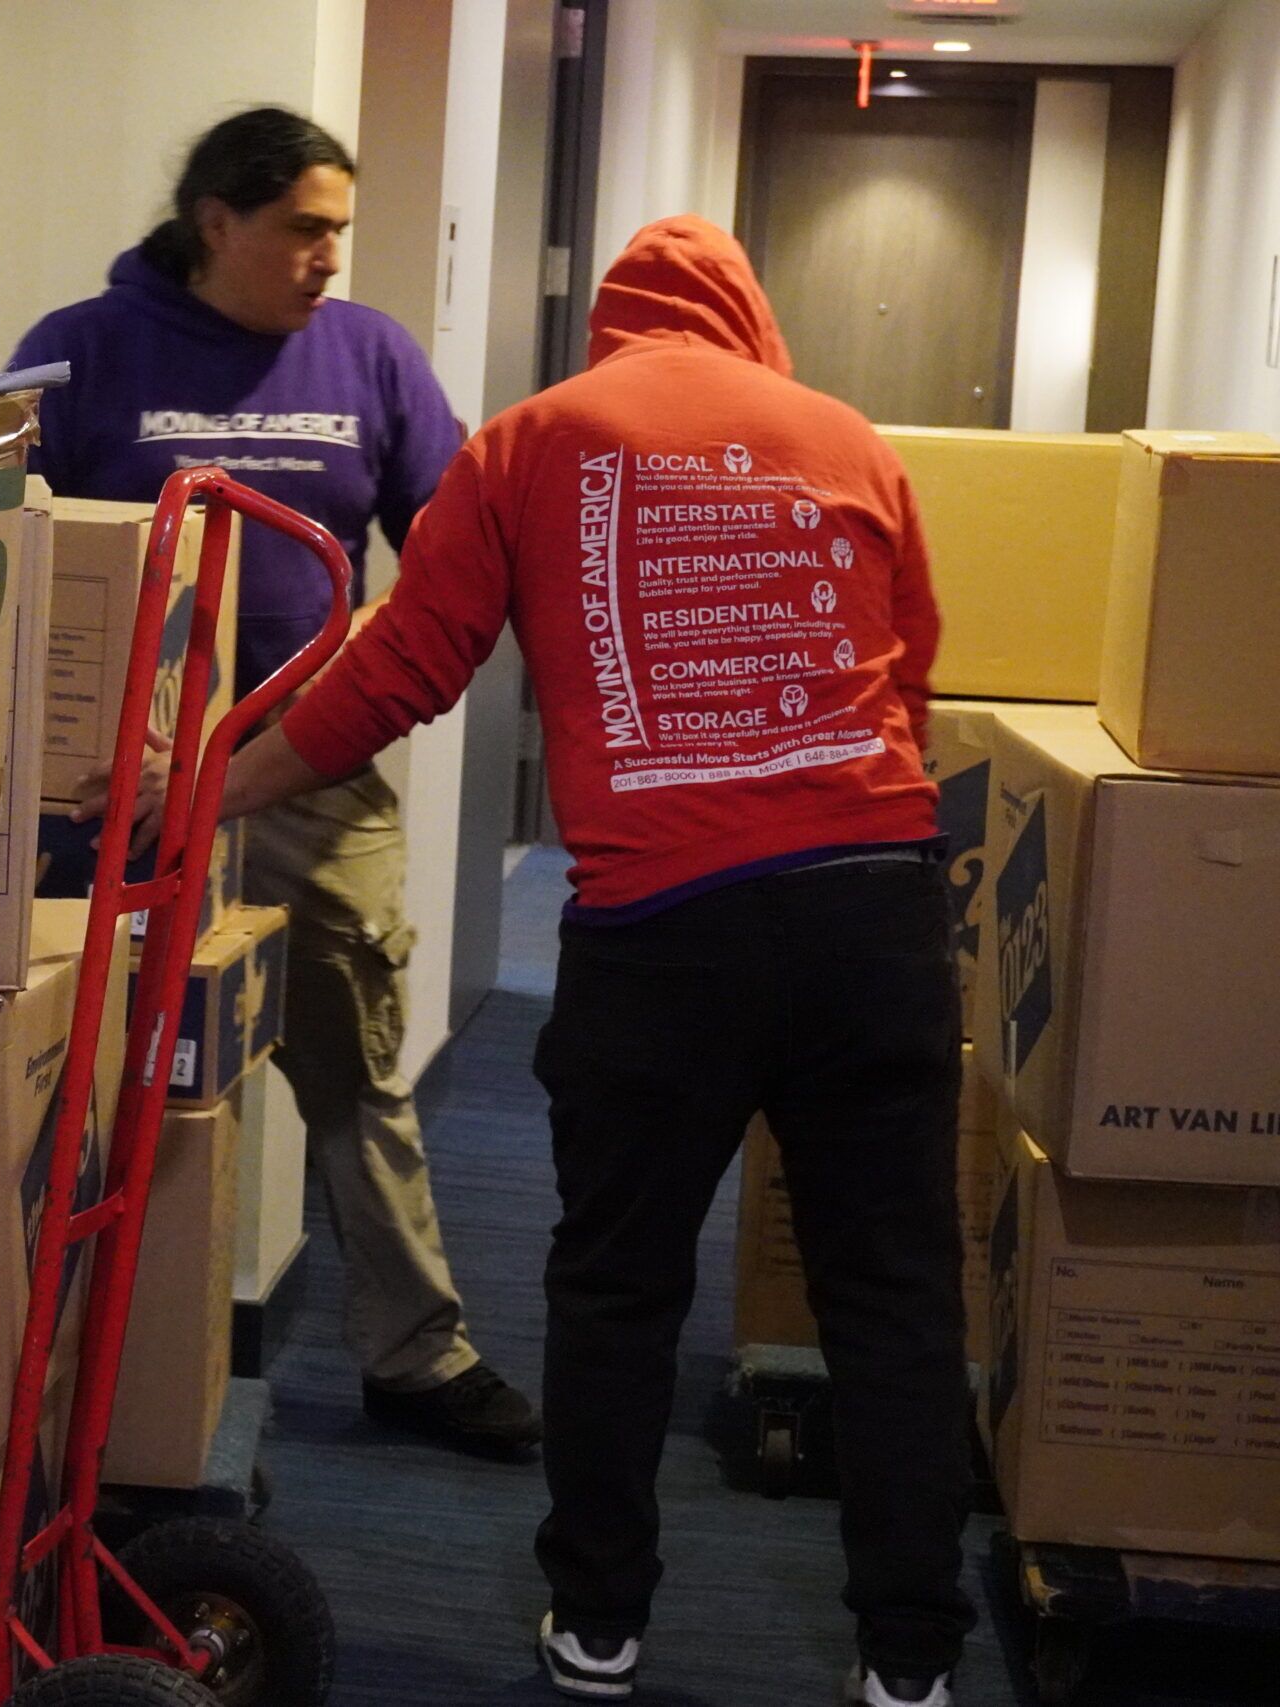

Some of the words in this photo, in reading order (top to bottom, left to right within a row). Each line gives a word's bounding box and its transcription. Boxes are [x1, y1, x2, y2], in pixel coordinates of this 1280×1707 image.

[635, 454, 713, 472] LOCAL
[635, 474, 651, 482] You
[697, 474, 717, 484] truly
[635, 484, 658, 492] Price
[723, 483, 741, 491] and
[580, 452, 617, 587] AMERICA
[637, 503, 776, 525] INTERSTATE
[636, 525, 676, 535] Personal
[678, 524, 720, 533] attention
[636, 536, 654, 546] Life
[655, 536, 663, 544] is
[665, 535, 691, 545] good,
[693, 534, 717, 543] enjoy
[719, 533, 736, 541] the
[737, 532, 759, 540] ride.
[638, 550, 824, 578] INTERNATIONAL
[638, 577, 674, 589] Quality,
[676, 575, 698, 584] trust
[700, 574, 718, 583] and
[719, 571, 782, 584] performance.
[638, 587, 673, 599] Bubble
[674, 586, 699, 596] wrap
[700, 583, 714, 593] for
[716, 583, 737, 593] your
[739, 581, 761, 590] soul.
[582, 593, 610, 633] OF
[642, 602, 799, 631] RESIDENTIAL
[644, 632, 659, 641] We
[660, 630, 675, 639] will
[677, 628, 701, 639] keep
[702, 625, 750, 637] everything
[673, 640, 689, 649] you
[691, 638, 706, 646] will
[707, 637, 719, 645] be
[765, 631, 808, 641] especially
[650, 651, 816, 681] COMMERCIAL
[651, 682, 668, 691] You
[670, 680, 695, 690] know
[696, 680, 716, 690] your
[717, 676, 759, 688] business,
[776, 672, 800, 681] know
[590, 636, 642, 748] MOVING
[652, 691, 676, 700] Work
[678, 689, 702, 699] hard,
[703, 689, 729, 698] move
[657, 708, 768, 732] STORAGE
[682, 732, 699, 741] box
[708, 731, 720, 742] up
[722, 728, 762, 740] carefully
[762, 725, 779, 736] and
[781, 722, 803, 733] store
[614, 760, 623, 770] A
[624, 753, 693, 769] Successful
[696, 752, 730, 764] Move
[732, 750, 770, 763] Starts
[771, 738, 801, 754] With
[802, 730, 835, 745] Great
[836, 727, 873, 741] Movers
[759, 757, 793, 774] MOVE
[176, 1058, 187, 1076] 2
[1100, 1105, 1160, 1129] ART
[1169, 1107, 1238, 1134] VAN
[1056, 1266, 1078, 1279] No.
[1203, 1275, 1244, 1290] Name
